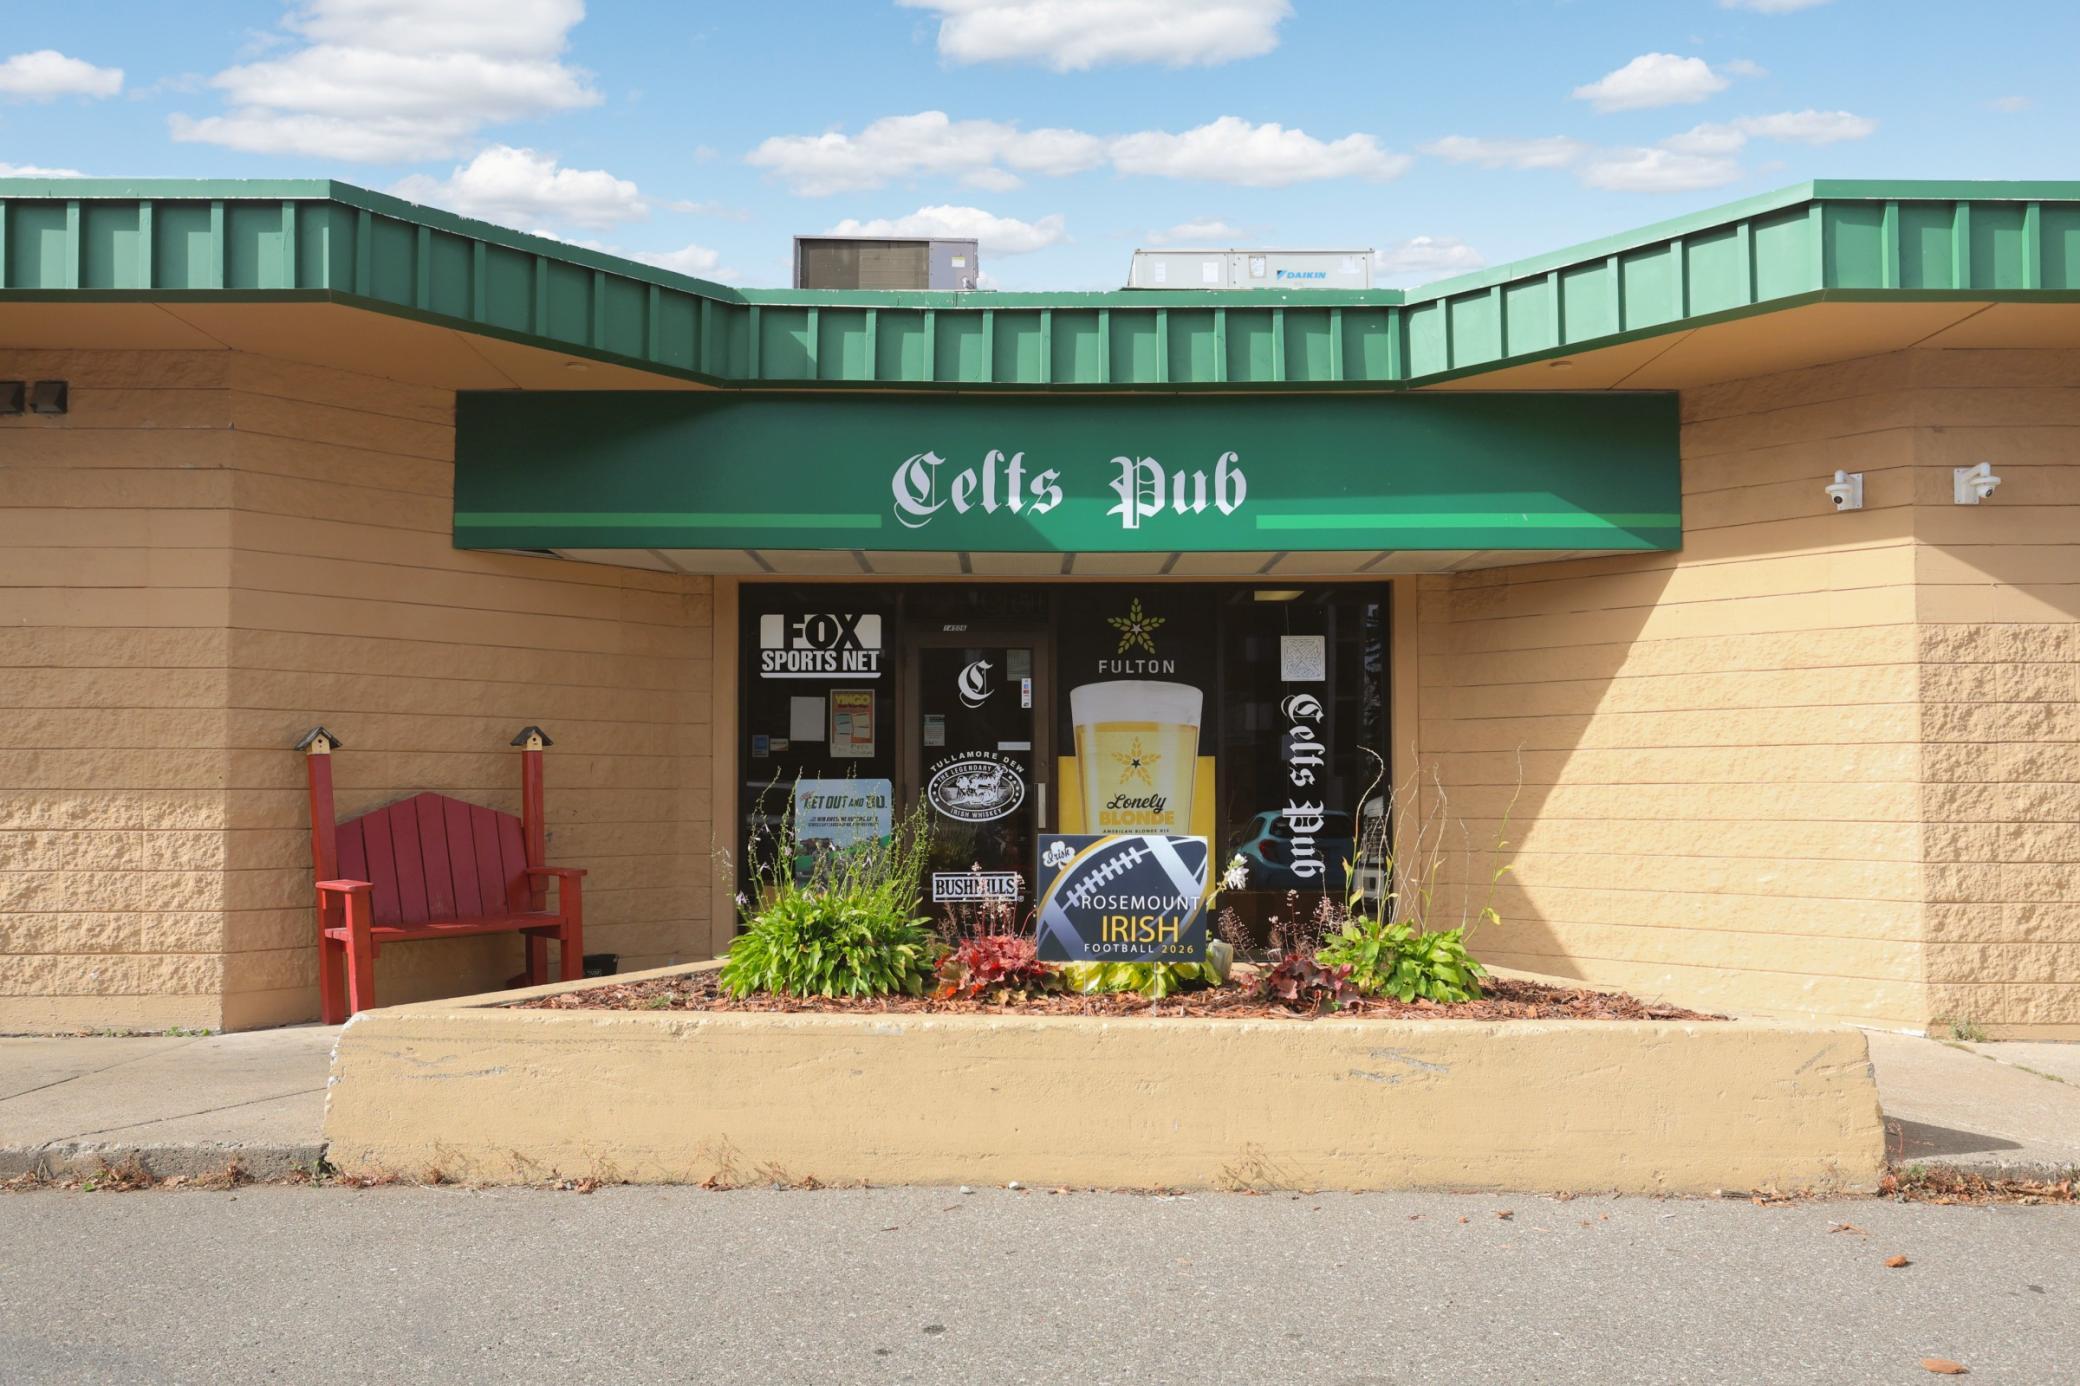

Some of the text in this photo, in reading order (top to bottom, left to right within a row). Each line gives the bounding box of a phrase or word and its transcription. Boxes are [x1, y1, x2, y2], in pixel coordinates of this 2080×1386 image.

[1287, 271, 1327, 279] DAIKIN
[891, 449, 1247, 529] Celts Pub
[783, 614, 864, 649] FOX
[761, 650, 880, 672] SPORTS NET
[1098, 659, 1176, 674] FULTON
[958, 659, 995, 709] C
[930, 751, 1025, 774] TULLAMORE DEW
[937, 764, 992, 783] THE LEGENDARY
[1280, 693, 1326, 878] Celts Pub
[825, 795, 849, 809] OUT
[848, 798, 865, 808] AND
[1106, 792, 1167, 814] Lonely
[950, 808, 1003, 818] IRISH WHISKEY
[1099, 810, 1175, 825] BLONDE
[1047, 848, 1070, 864] Irish
[1081, 895, 1200, 911] ROSEMOUNT
[1102, 915, 1179, 942] IRISH
[1084, 943, 1195, 954] FOOTBALL 2026
